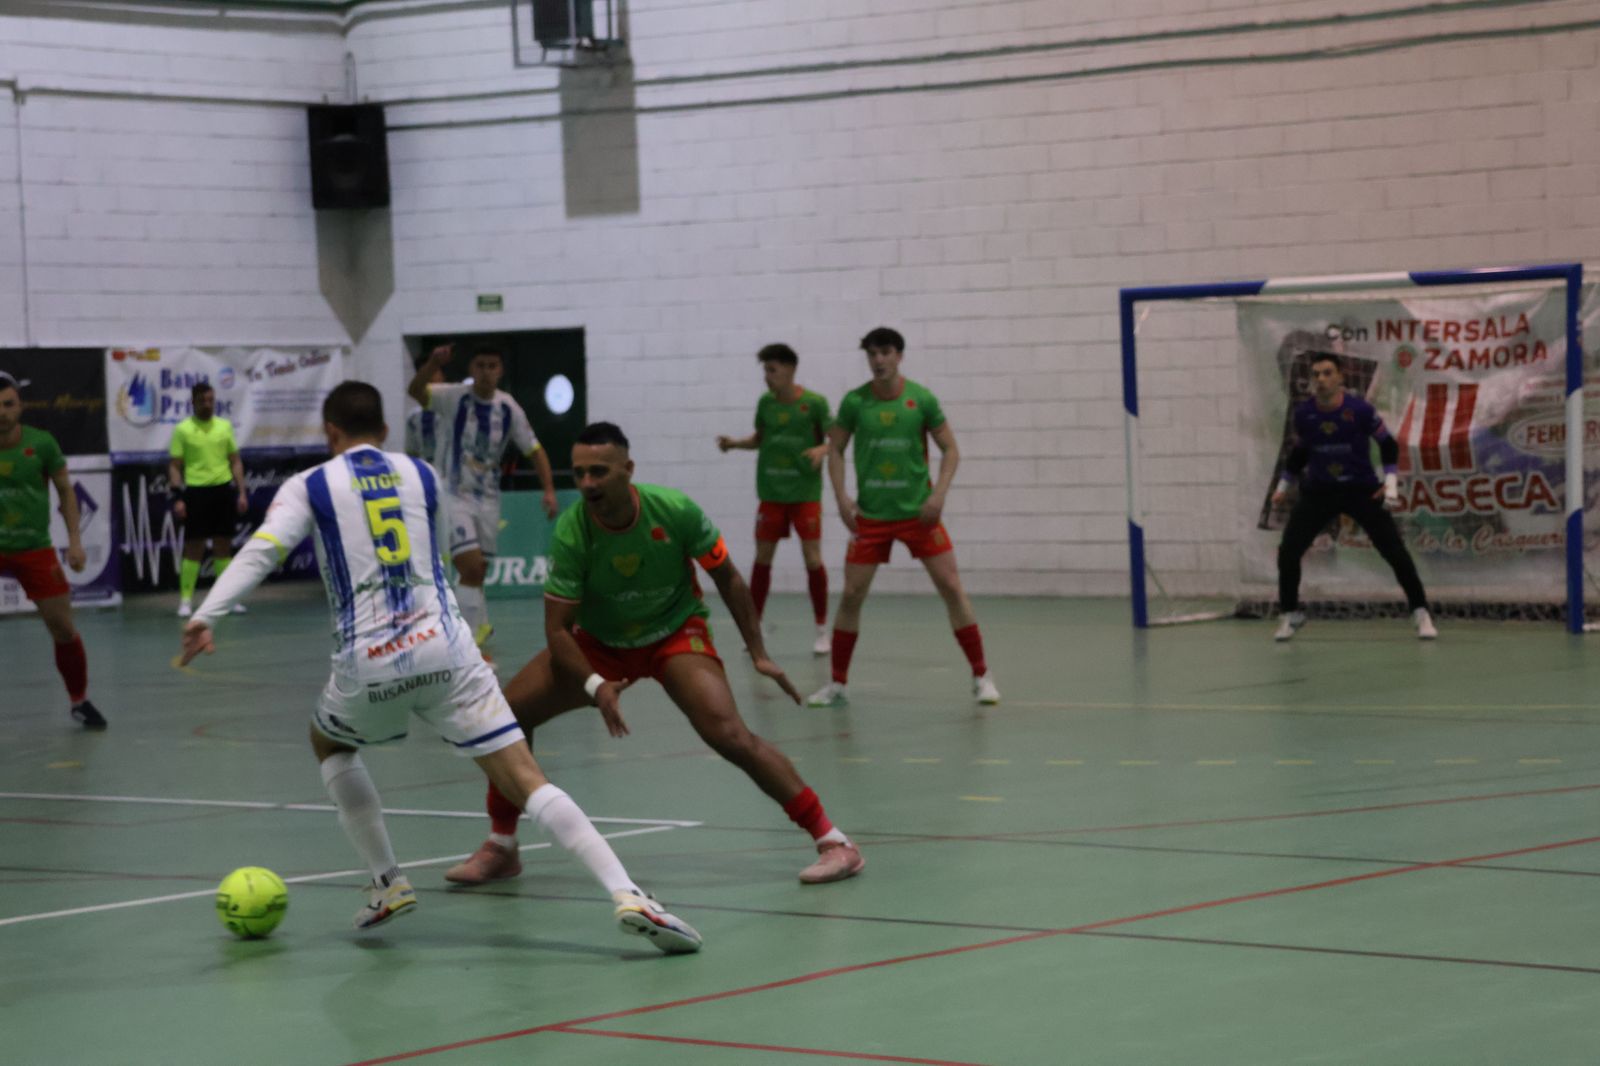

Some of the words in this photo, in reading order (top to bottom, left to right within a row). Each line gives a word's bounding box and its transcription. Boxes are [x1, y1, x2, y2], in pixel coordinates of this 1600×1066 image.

[1376, 313, 1531, 343] INTERSALA
[1424, 341, 1548, 371] ZAMORA
[364, 497, 411, 566] 5
[368, 670, 452, 703] BUSANAUTO
